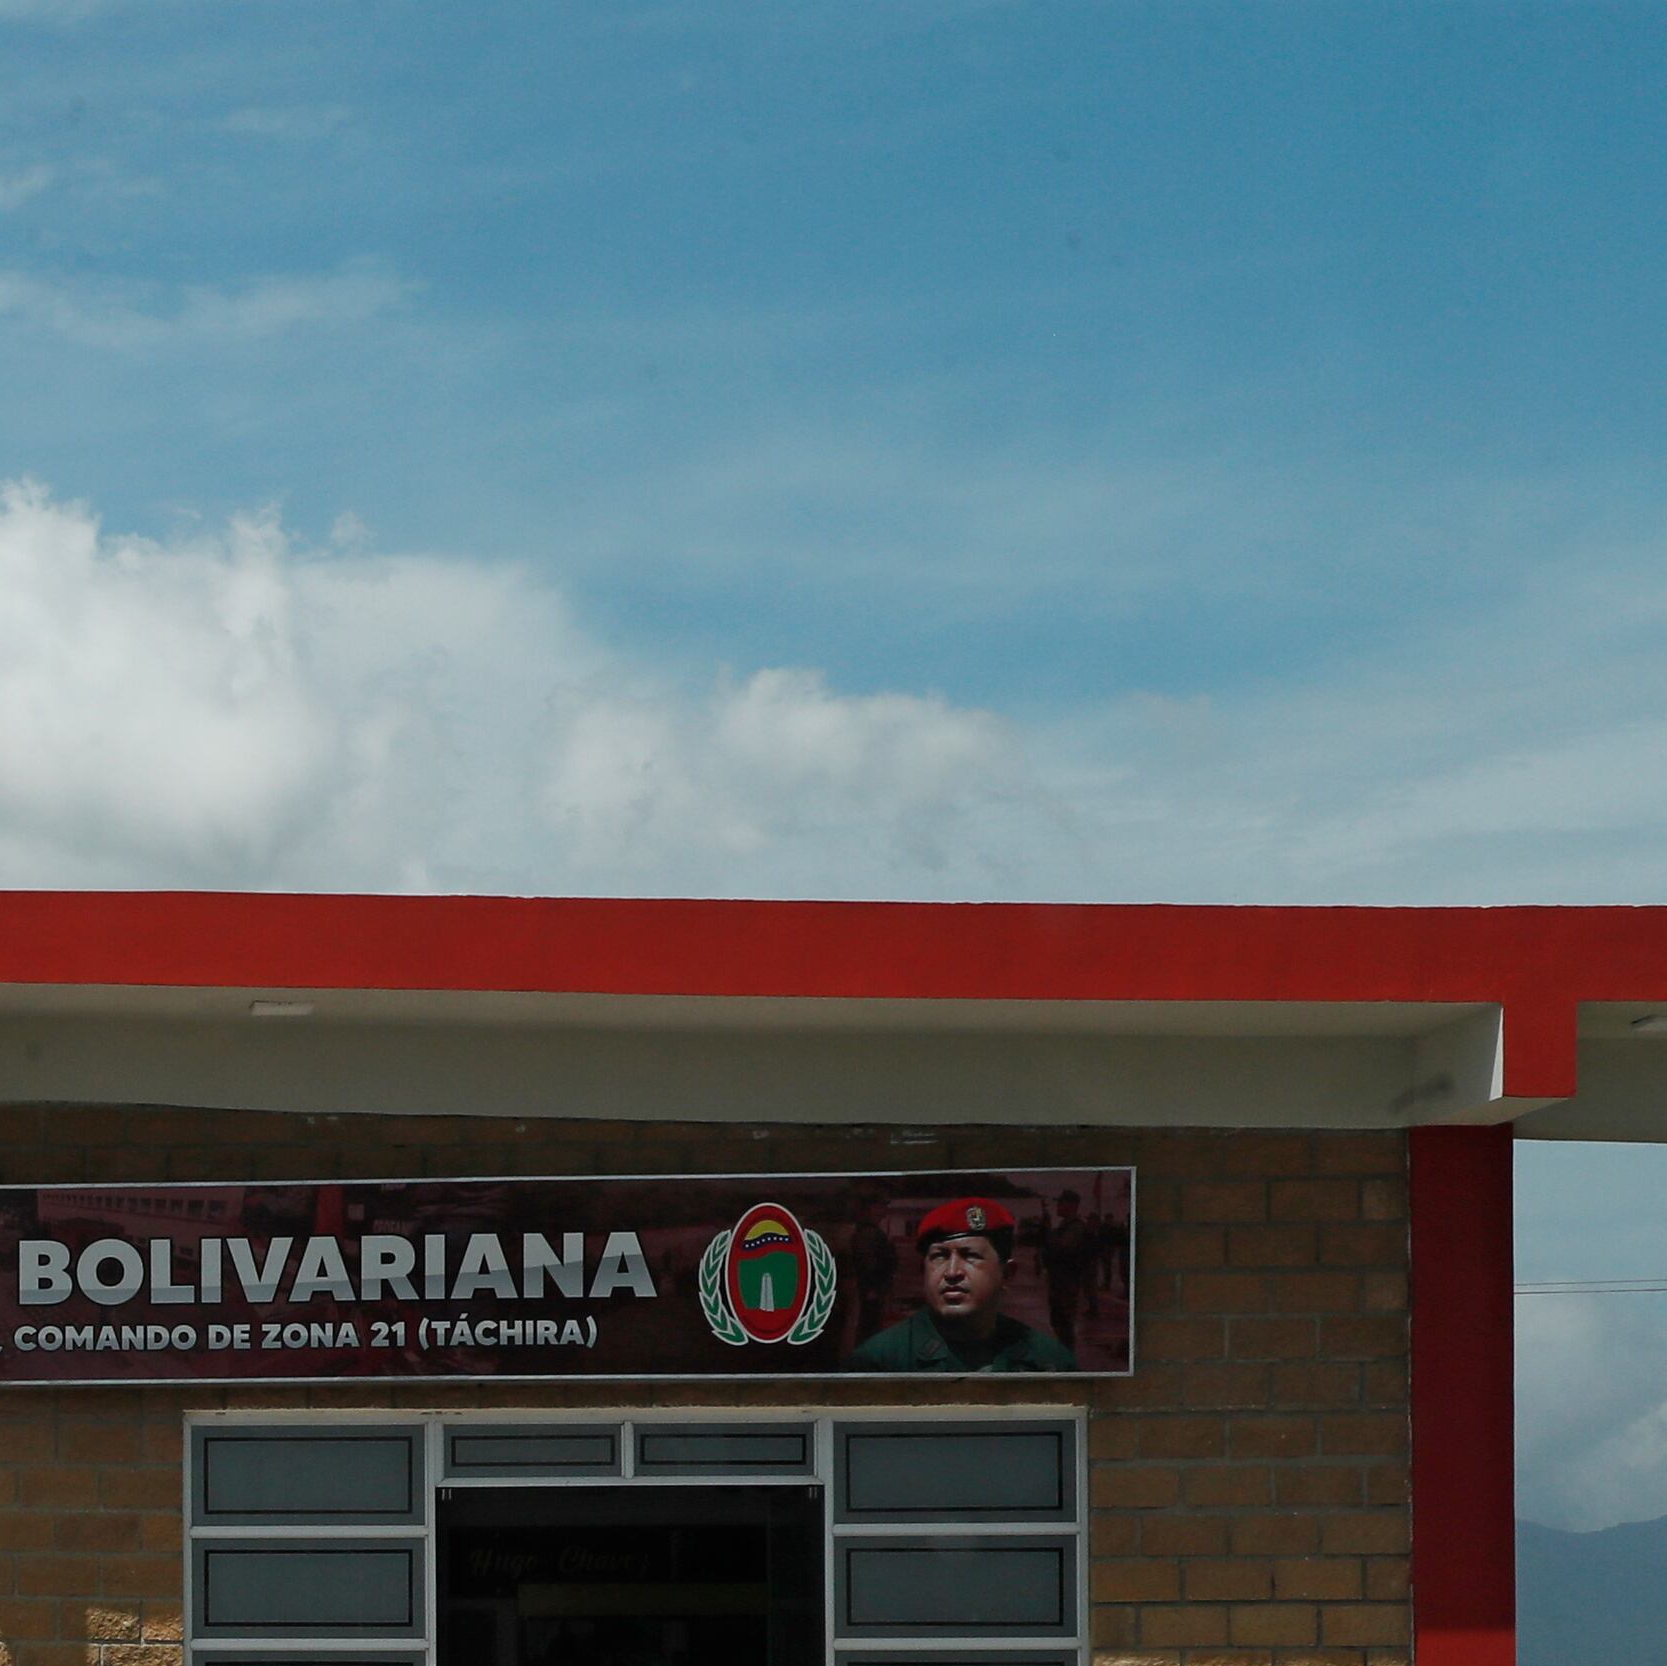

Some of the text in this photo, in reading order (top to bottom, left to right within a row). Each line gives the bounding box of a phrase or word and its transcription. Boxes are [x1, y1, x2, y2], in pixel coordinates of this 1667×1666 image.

[19, 1231, 658, 1307] BOLIVARIANA
[14, 1324, 197, 1352] COMANDO
[208, 1324, 251, 1350] DE
[261, 1322, 359, 1350] ZONA
[370, 1321, 405, 1348] 21
[418, 1312, 598, 1350] (TÁCHIRA)
